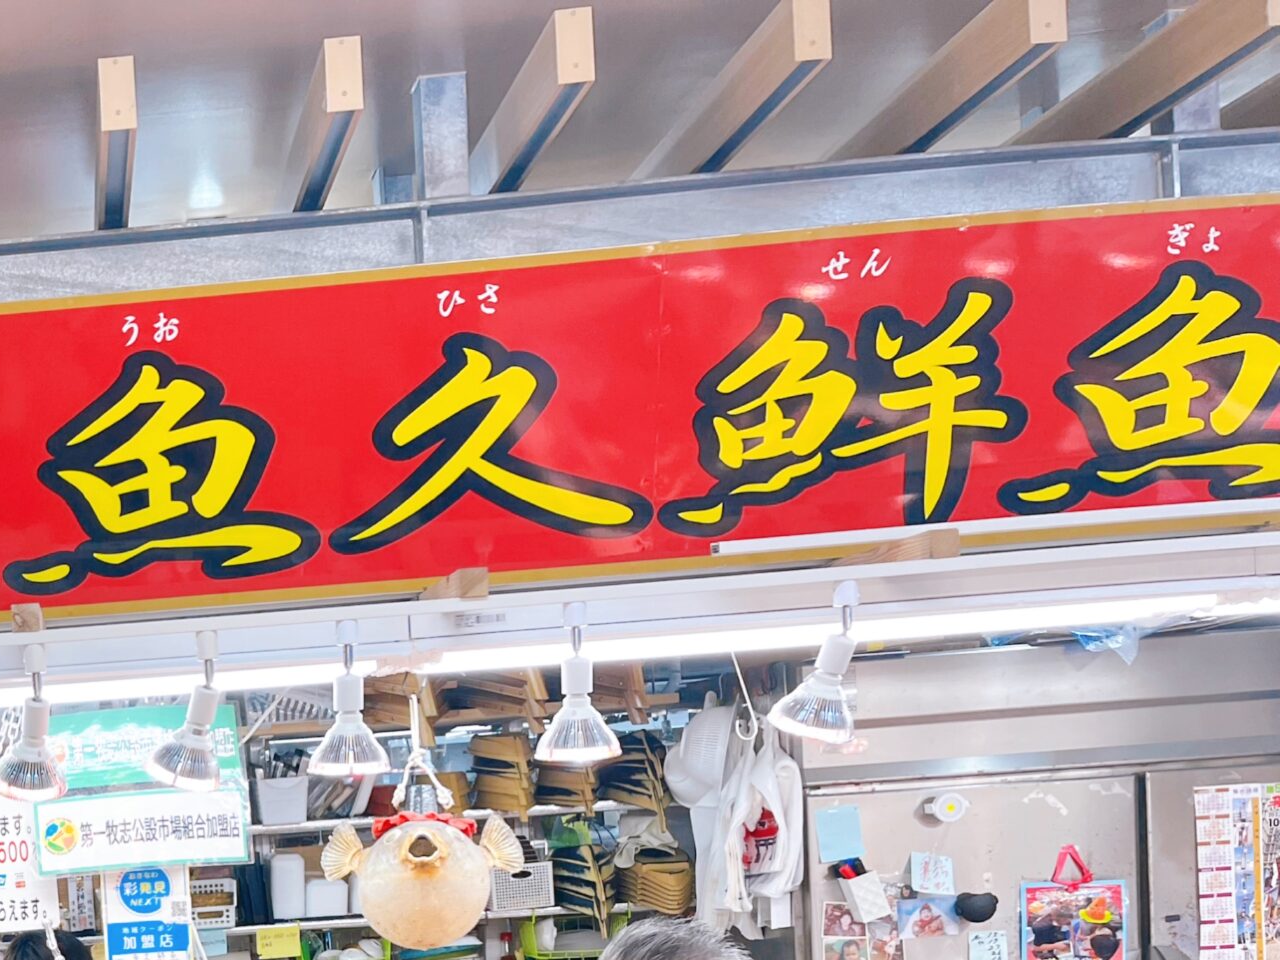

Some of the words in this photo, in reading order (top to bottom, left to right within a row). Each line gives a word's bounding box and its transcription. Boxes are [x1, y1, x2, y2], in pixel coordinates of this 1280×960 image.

[121, 314, 179, 347] うお
[437, 284, 500, 317] ひさ
[821, 248, 892, 281] せん
[1166, 223, 1222, 256] ぎょ
[123, 934, 174, 950] 加盟店
